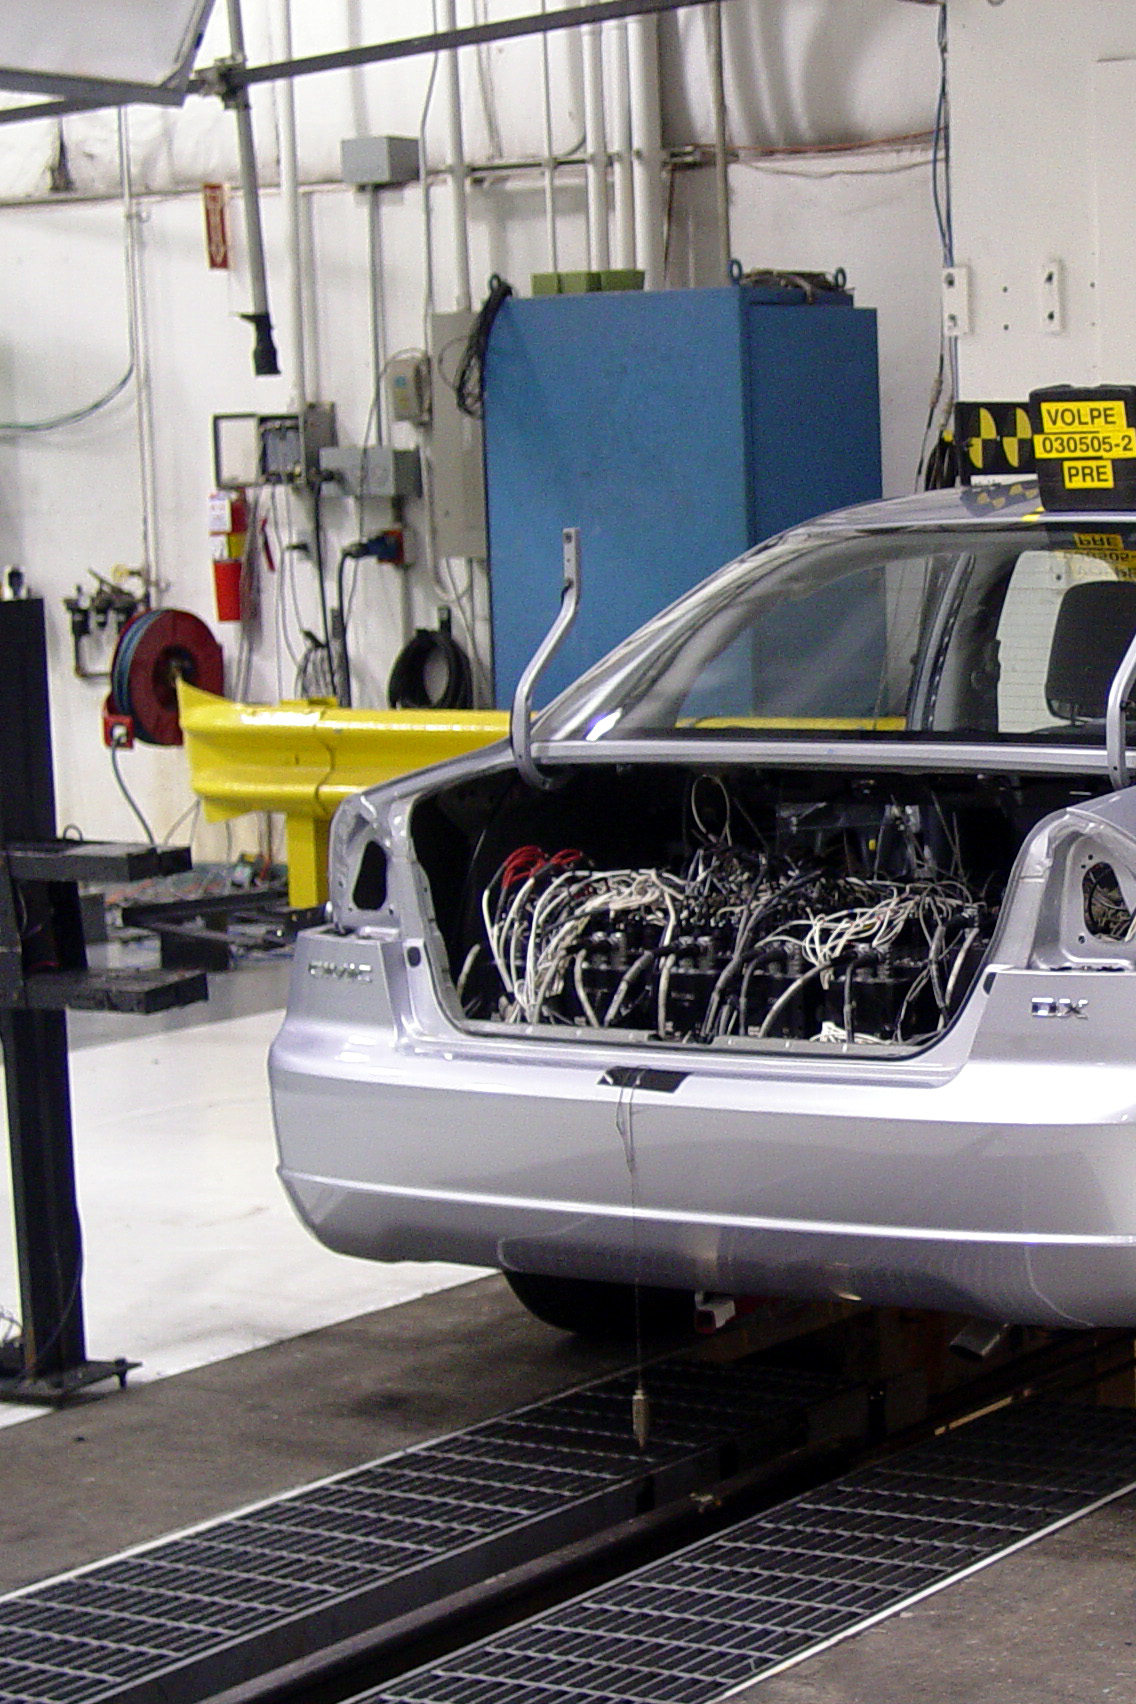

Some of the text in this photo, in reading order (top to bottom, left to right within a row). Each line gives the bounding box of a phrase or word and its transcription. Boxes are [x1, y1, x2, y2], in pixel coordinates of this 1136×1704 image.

[1046, 407, 1117, 426] VOLPE
[1042, 435, 1133, 453] 030505-2
[1067, 465, 1109, 483] PRE
[1031, 997, 1088, 1020] DX
